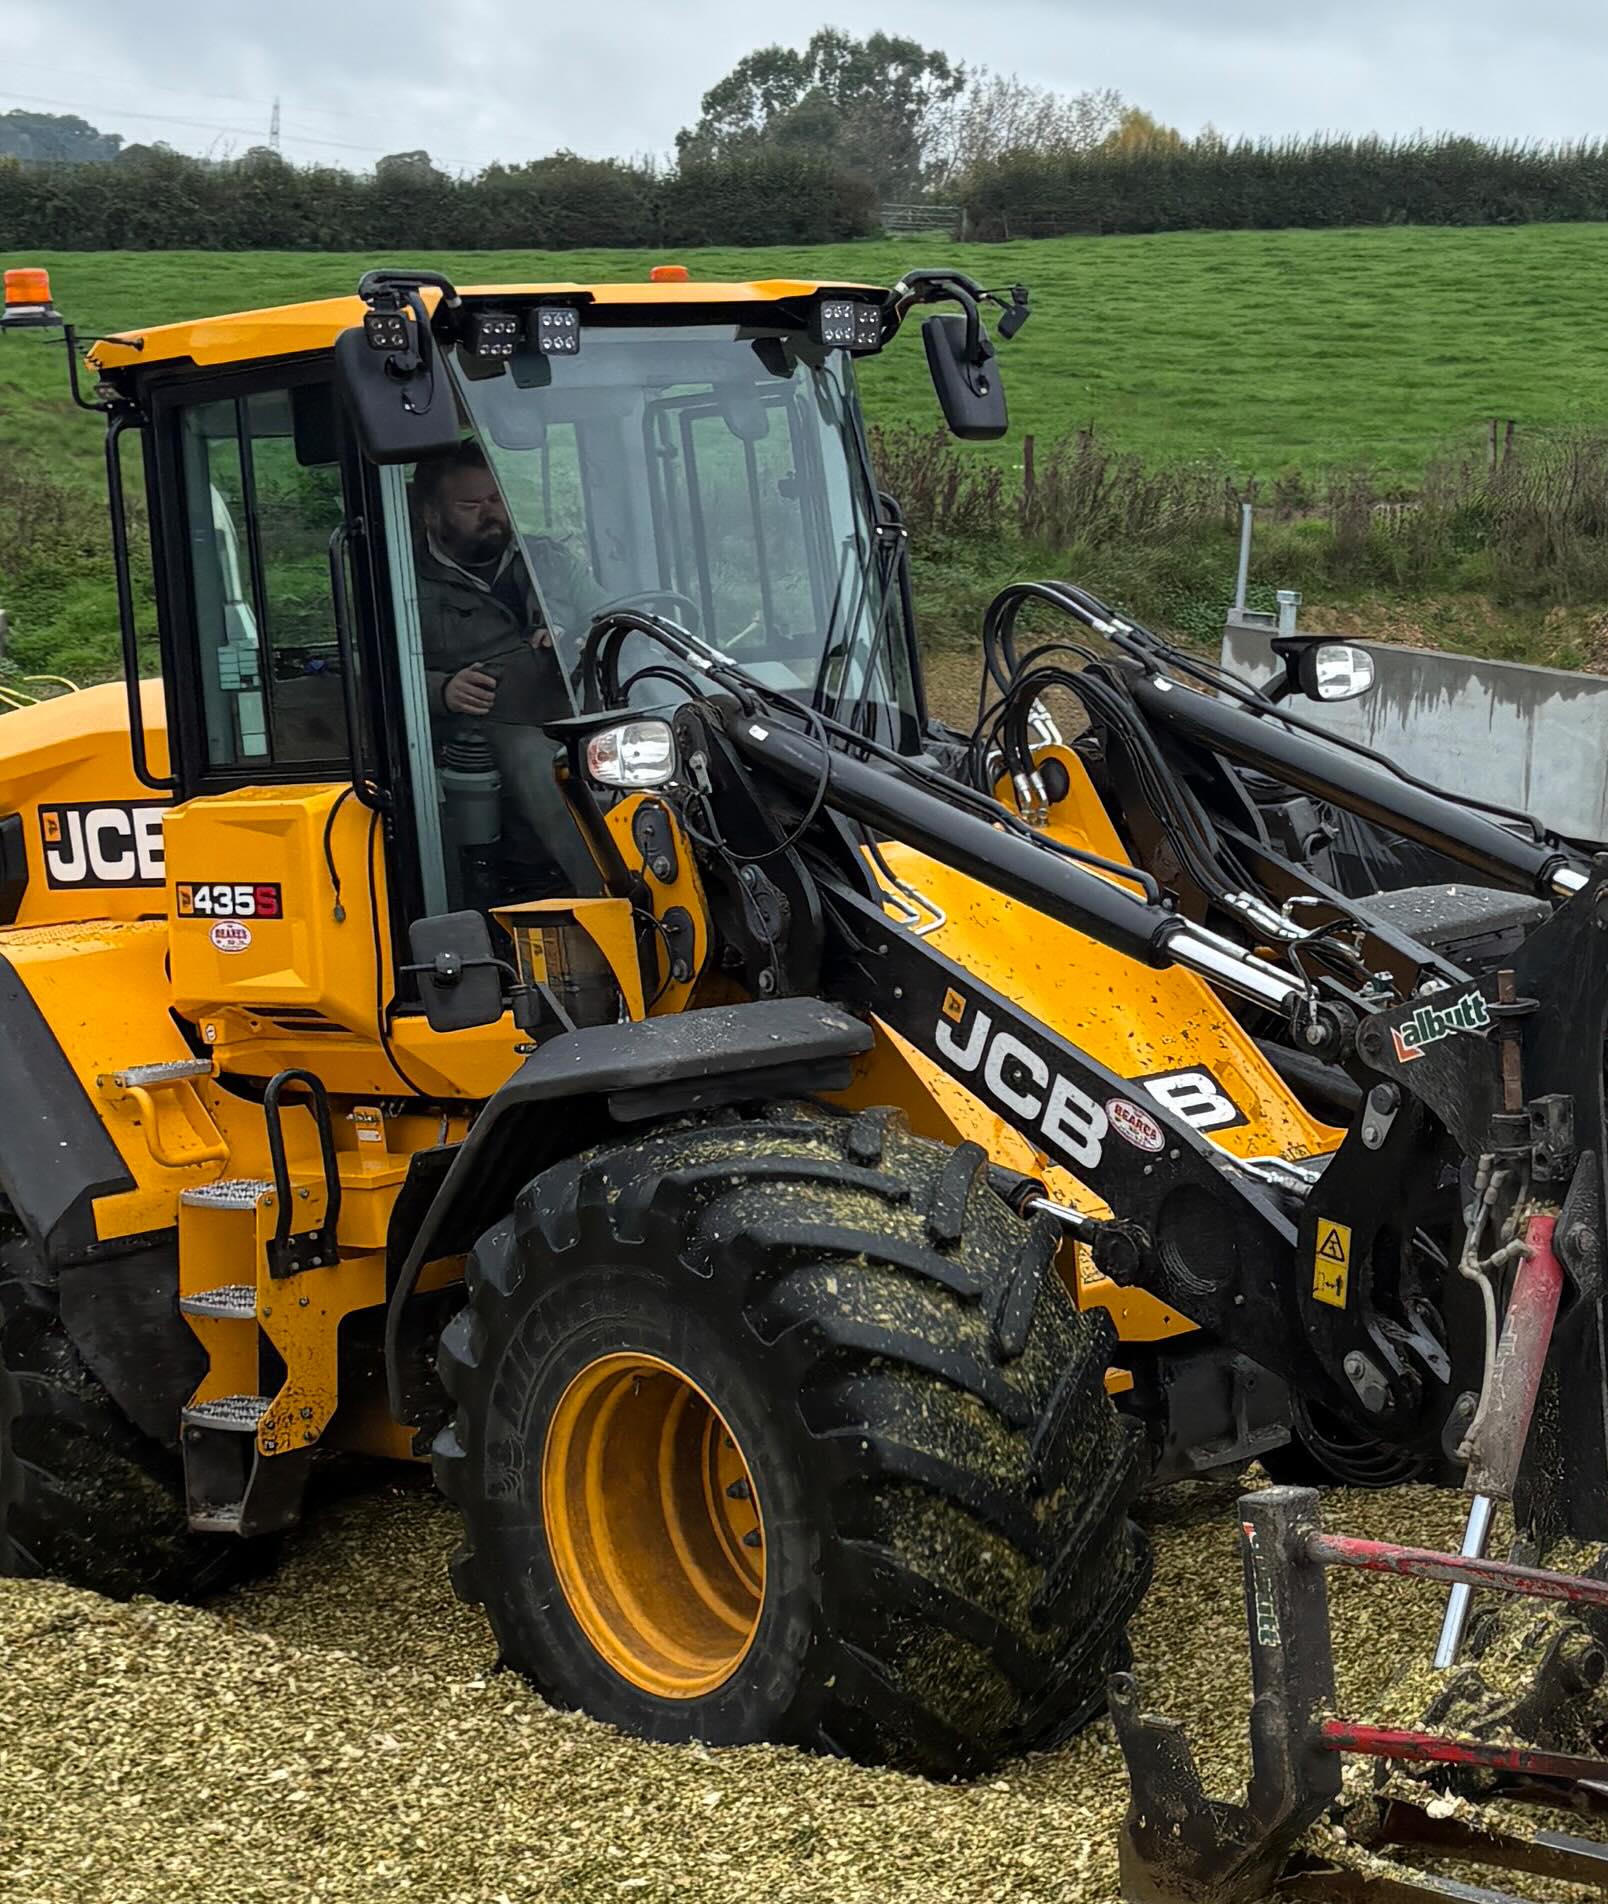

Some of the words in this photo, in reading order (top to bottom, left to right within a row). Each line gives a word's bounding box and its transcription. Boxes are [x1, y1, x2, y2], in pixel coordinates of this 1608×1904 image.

[194, 886, 277, 915] 435S
[1401, 991, 1490, 1051] albutt
[935, 1010, 1108, 1169] JCB
